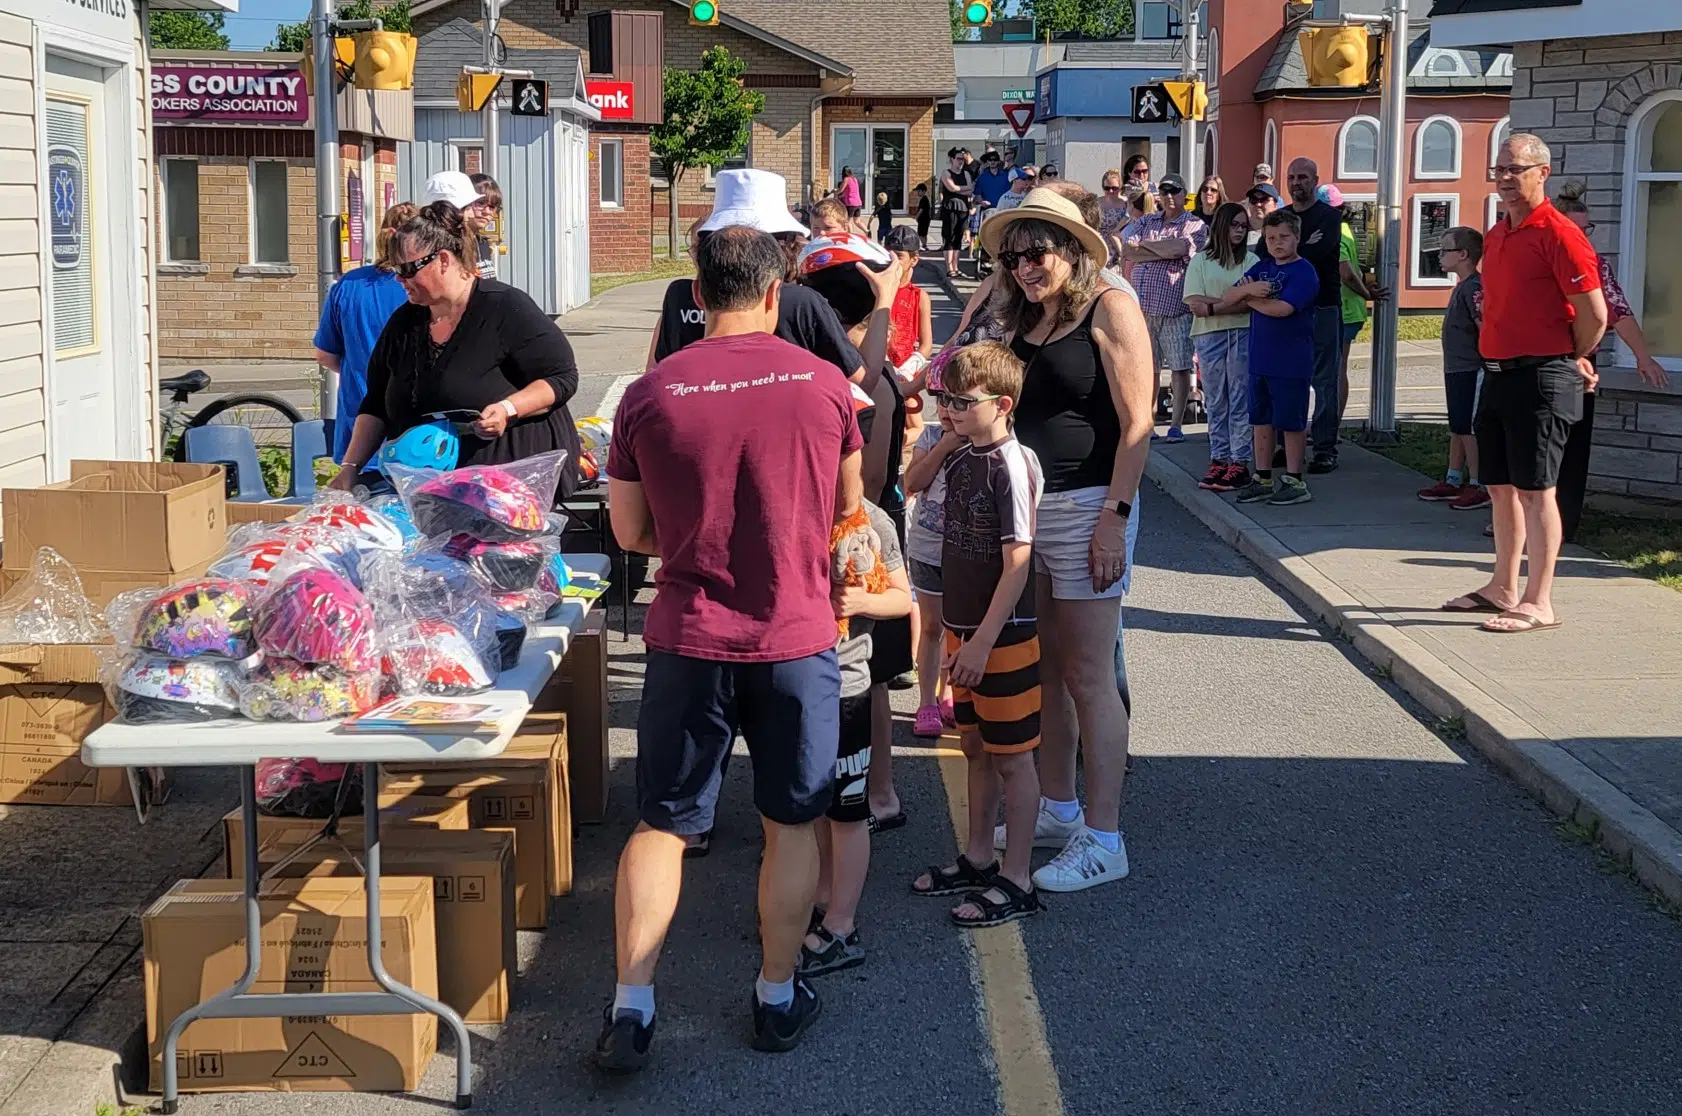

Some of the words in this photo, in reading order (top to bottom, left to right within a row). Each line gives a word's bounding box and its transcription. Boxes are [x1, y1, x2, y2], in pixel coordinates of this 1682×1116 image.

[188, 75, 301, 96] COUNTY
[588, 90, 629, 108] ank
[1002, 91, 1023, 99] DIXON
[1025, 91, 1036, 99] WA
[202, 98, 298, 112] ASSOCIATION
[680, 309, 706, 324] VOL
[702, 380, 727, 392] when
[730, 381, 749, 392] you
[752, 372, 775, 386] need
[778, 373, 789, 382] us
[31, 691, 56, 699] CTC
[21, 756, 53, 764] CANADA
[291, 970, 331, 978] CANADA
[298, 1055, 328, 1066] CTC
